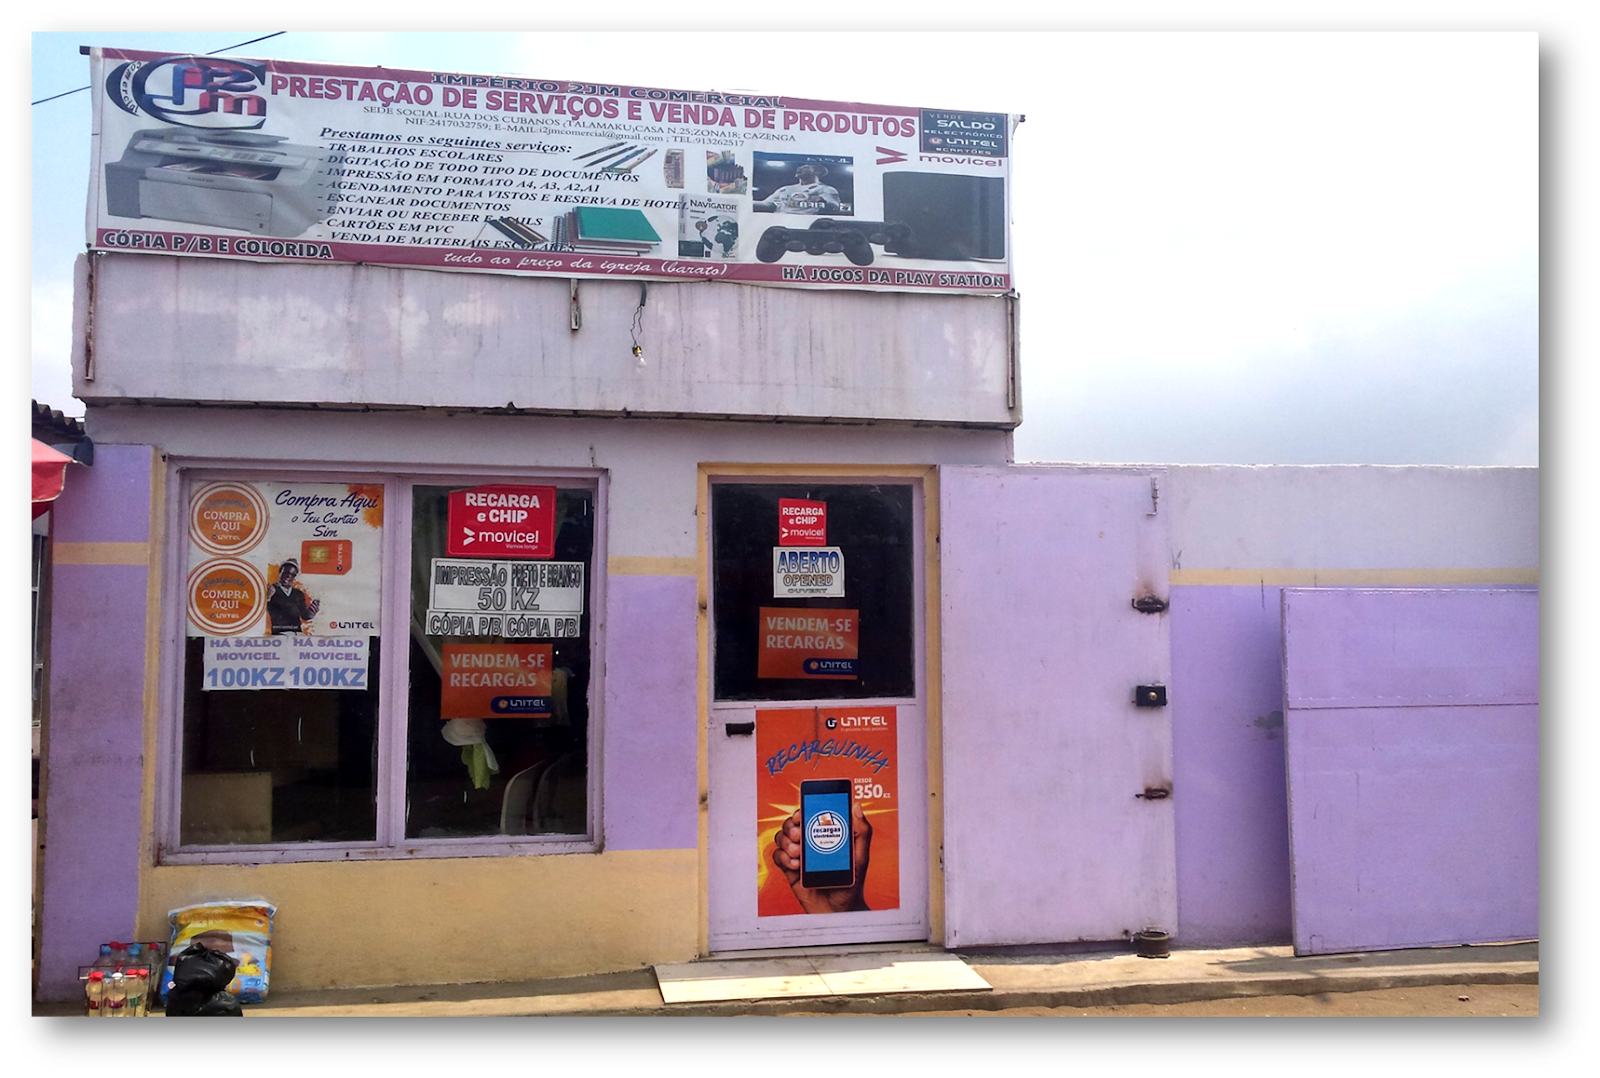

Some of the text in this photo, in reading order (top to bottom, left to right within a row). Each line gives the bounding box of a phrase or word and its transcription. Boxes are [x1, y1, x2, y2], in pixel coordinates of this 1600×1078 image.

[431, 73, 785, 108] IMPÉRIO 2JM COMERCIAL
[271, 74, 433, 107] PRESTAÇÃO
[443, 87, 477, 109] DE
[486, 90, 619, 120] SERVIÇOS
[628, 101, 642, 120] E
[650, 102, 737, 127] VENDA
[744, 109, 776, 129] DE
[784, 110, 916, 138] PRODUTOS
[363, 106, 393, 115] SEDE
[474, 113, 498, 122] DOS
[502, 115, 560, 126] CUBANOS
[743, 132, 796, 142] CAZENGA
[937, 119, 995, 130] SALDO
[319, 127, 572, 153] Prestamos os seguintes serviços:
[946, 138, 998, 148] UNITEL
[329, 143, 503, 162] TRABALHOS ESCOLARES
[919, 155, 1002, 167] movicel
[328, 155, 409, 169] DIGITAÇÃO
[414, 161, 434, 170] DE
[439, 162, 478, 174] TODO
[482, 166, 514, 176] TIPO
[518, 167, 538, 177] DE
[541, 168, 640, 183] DOCUMENTOS
[327, 168, 412, 181] IMPRESSÃO
[415, 174, 438, 183] EM
[443, 176, 513, 187] FORMATO
[516, 180, 536, 190] A4,
[540, 181, 560, 191] A3,
[326, 182, 442, 196] AGENDAMENTO
[446, 189, 483, 198] PARA
[487, 190, 537, 201] VISTOS
[540, 193, 550, 202] E
[554, 194, 616, 206] RESERVA
[620, 198, 640, 207] DE
[643, 199, 689, 210] HOTEL
[327, 193, 511, 212] ESCANEAR DOCUMENTOS
[327, 206, 543, 226] ENVIAR OU RECEBER EILS
[326, 218, 454, 234] CARTÕES EM PVC
[103, 230, 333, 259] CÓPIA P/B E COLORIDA
[331, 231, 381, 243] VENDA
[385, 235, 405, 244] DE
[410, 237, 490, 249] MATERIAIS
[444, 251, 728, 276] tudo ao preço da igreja (barato)
[782, 265, 1005, 288] HÁ JOGOS DA PLAY STATION
[275, 489, 337, 512] Compra
[340, 491, 380, 513] Aqui
[465, 492, 540, 508] RECARGA
[203, 511, 250, 520] COMPRA
[302, 511, 320, 523] Teu
[323, 512, 359, 525] Cartão
[477, 509, 528, 524] e CHIP
[782, 507, 824, 516] RECARGA
[213, 521, 240, 532] AQUI
[795, 516, 817, 525] CHIP
[312, 525, 338, 537] Sim
[479, 530, 539, 543] movicel
[790, 528, 824, 536] movicel
[777, 551, 840, 574] ABERTO
[435, 563, 581, 589] IMPRESSÃO PRETO E BRANCO
[783, 575, 833, 587] OPENED
[201, 589, 249, 599] COMPRA
[477, 587, 540, 611] 50 KZ
[211, 600, 239, 610] AQUI
[430, 612, 502, 636] CÓPIA P/B
[507, 614, 577, 638] CÓPIA P/B
[766, 617, 852, 632] VENDEM-SE
[210, 638, 282, 648] HÁ SALDO
[293, 637, 364, 648] HÁ SALDO
[766, 635, 844, 650] RECARGAS
[216, 652, 281, 661] MOVICEL
[299, 652, 362, 661] MOVICEL
[451, 653, 545, 668] VENDEM-SE
[820, 661, 852, 669] UNITEL
[207, 667, 285, 687] 100KZ
[289, 667, 366, 687] 100KZ
[450, 672, 537, 687] RECARGAS
[510, 699, 546, 707] UNITEL
[841, 716, 888, 727] UNITEL
[765, 738, 889, 777] RECARGUINHA
[854, 784, 883, 799] 350
